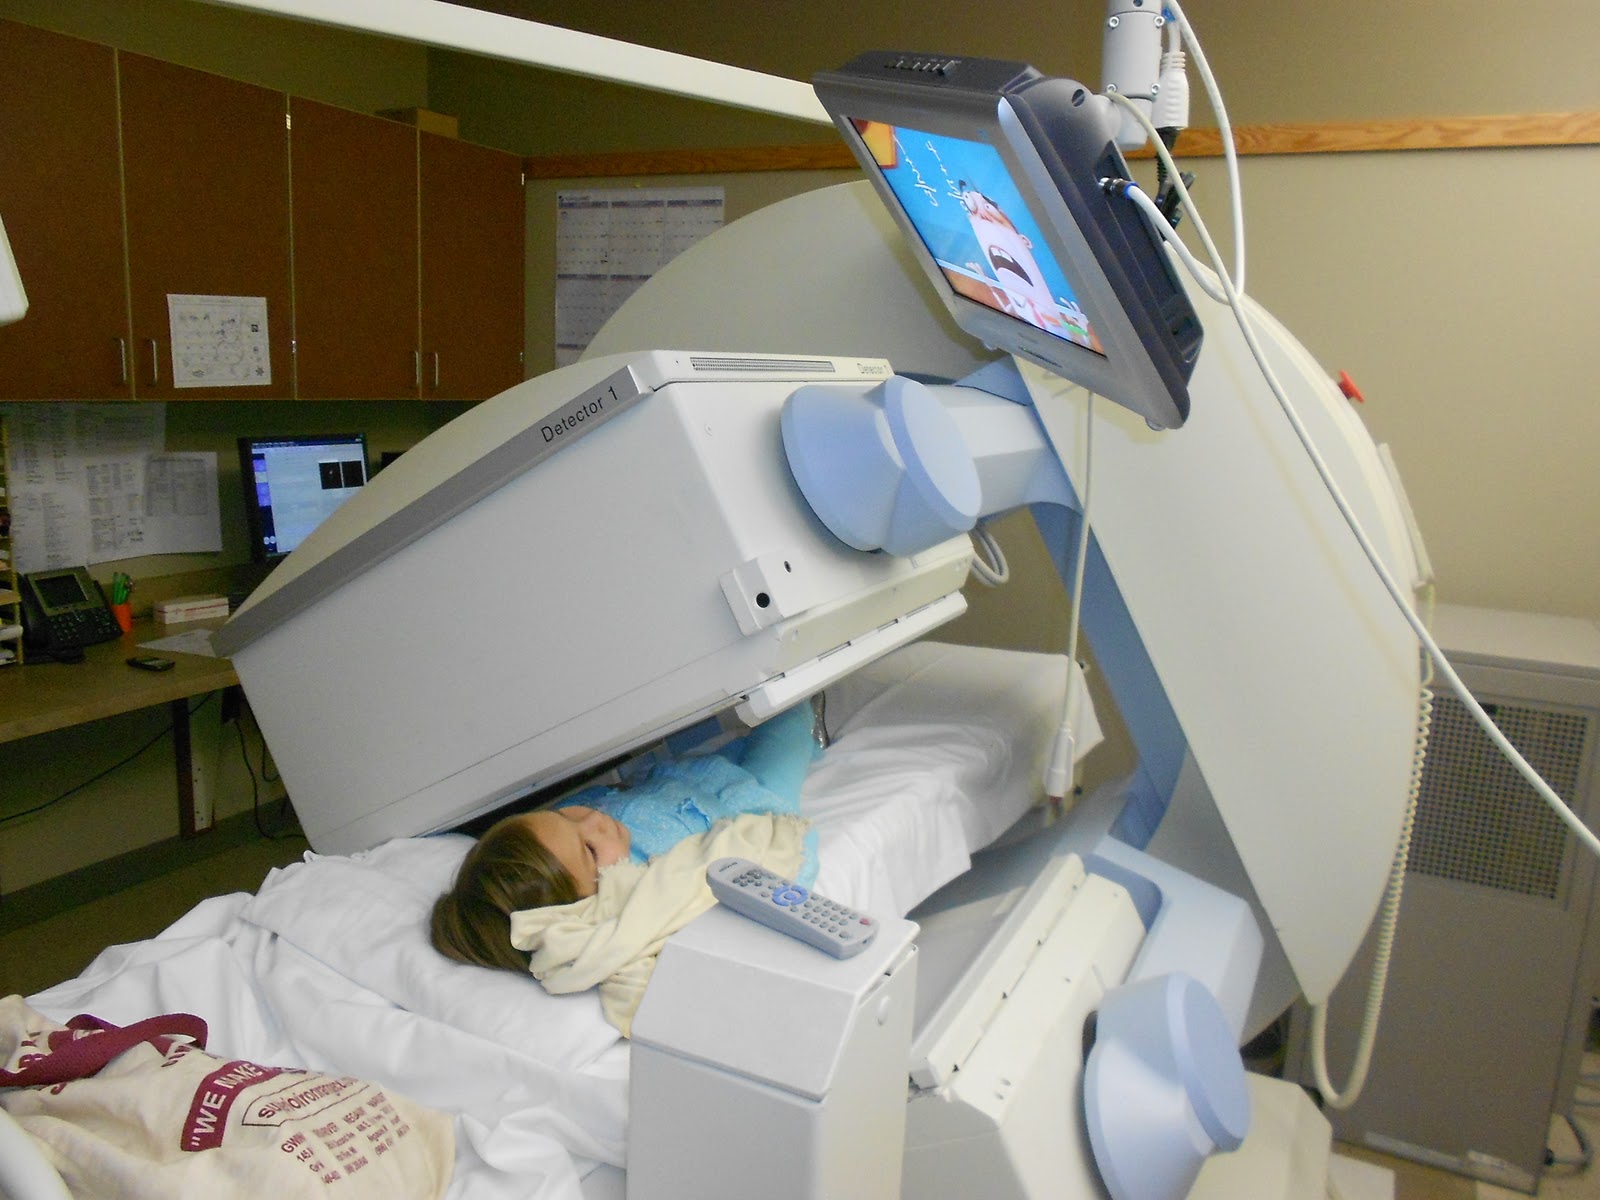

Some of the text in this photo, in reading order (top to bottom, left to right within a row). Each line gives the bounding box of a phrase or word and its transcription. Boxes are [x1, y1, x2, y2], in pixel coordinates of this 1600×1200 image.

[540, 385, 618, 442] Detector 1
[214, 1063, 264, 1090] MAKE
